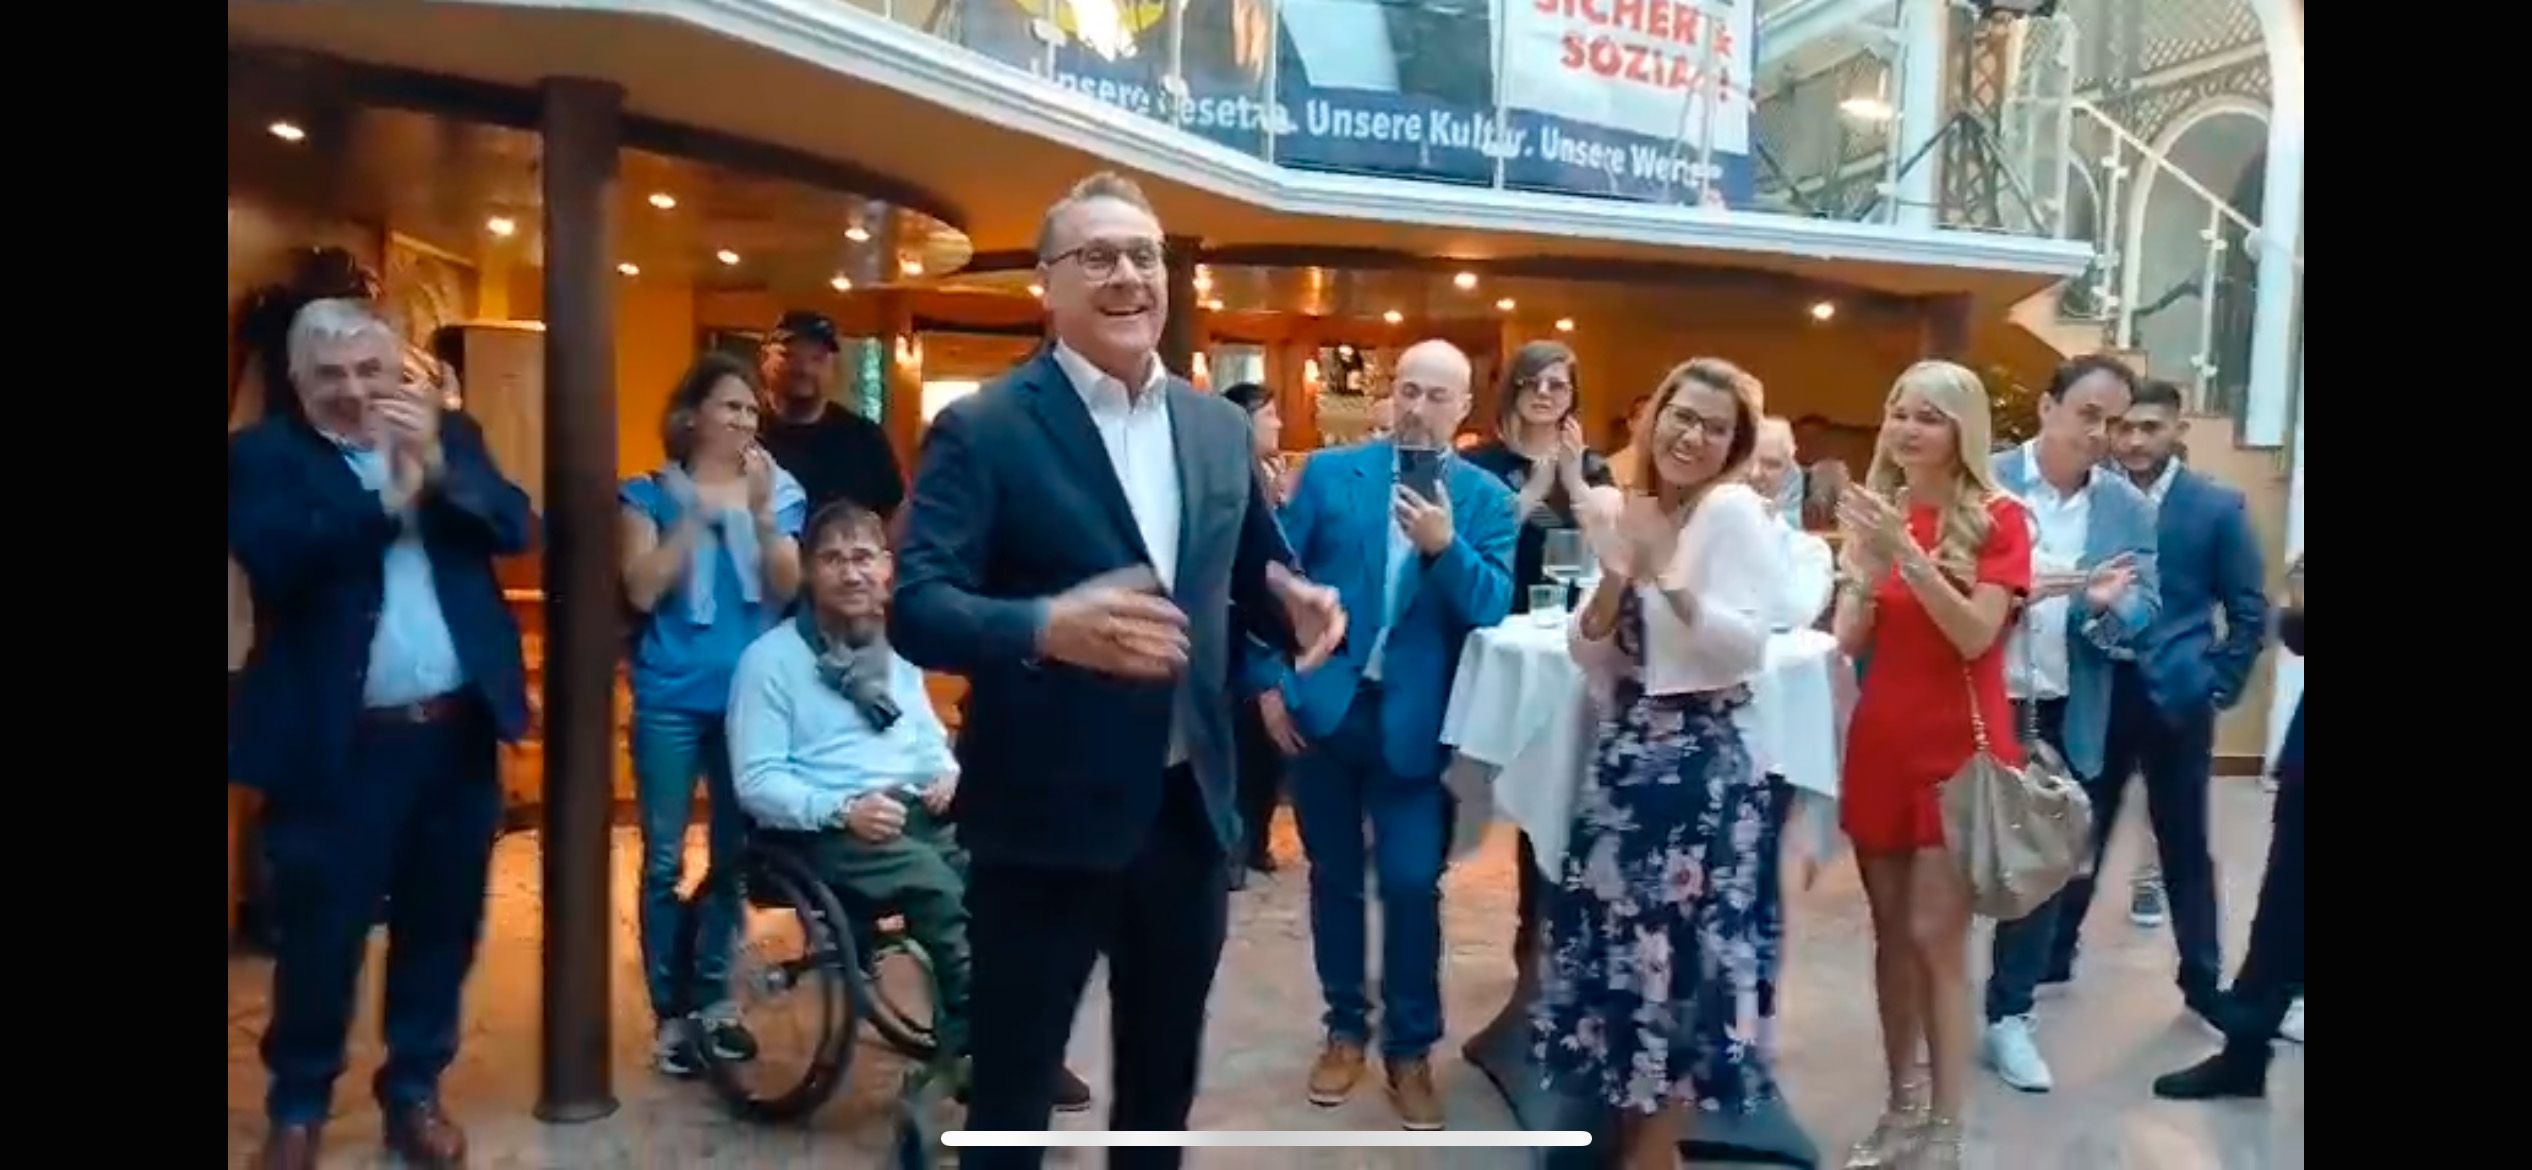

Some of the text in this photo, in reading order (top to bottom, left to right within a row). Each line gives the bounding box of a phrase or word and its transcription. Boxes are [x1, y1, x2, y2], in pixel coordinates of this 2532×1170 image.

[1560, 30, 1730, 102] SOZIA!
[1030, 57, 1150, 113] nsere
[1306, 99, 1421, 142] Unsere
[1540, 125, 1625, 174] Unsere
